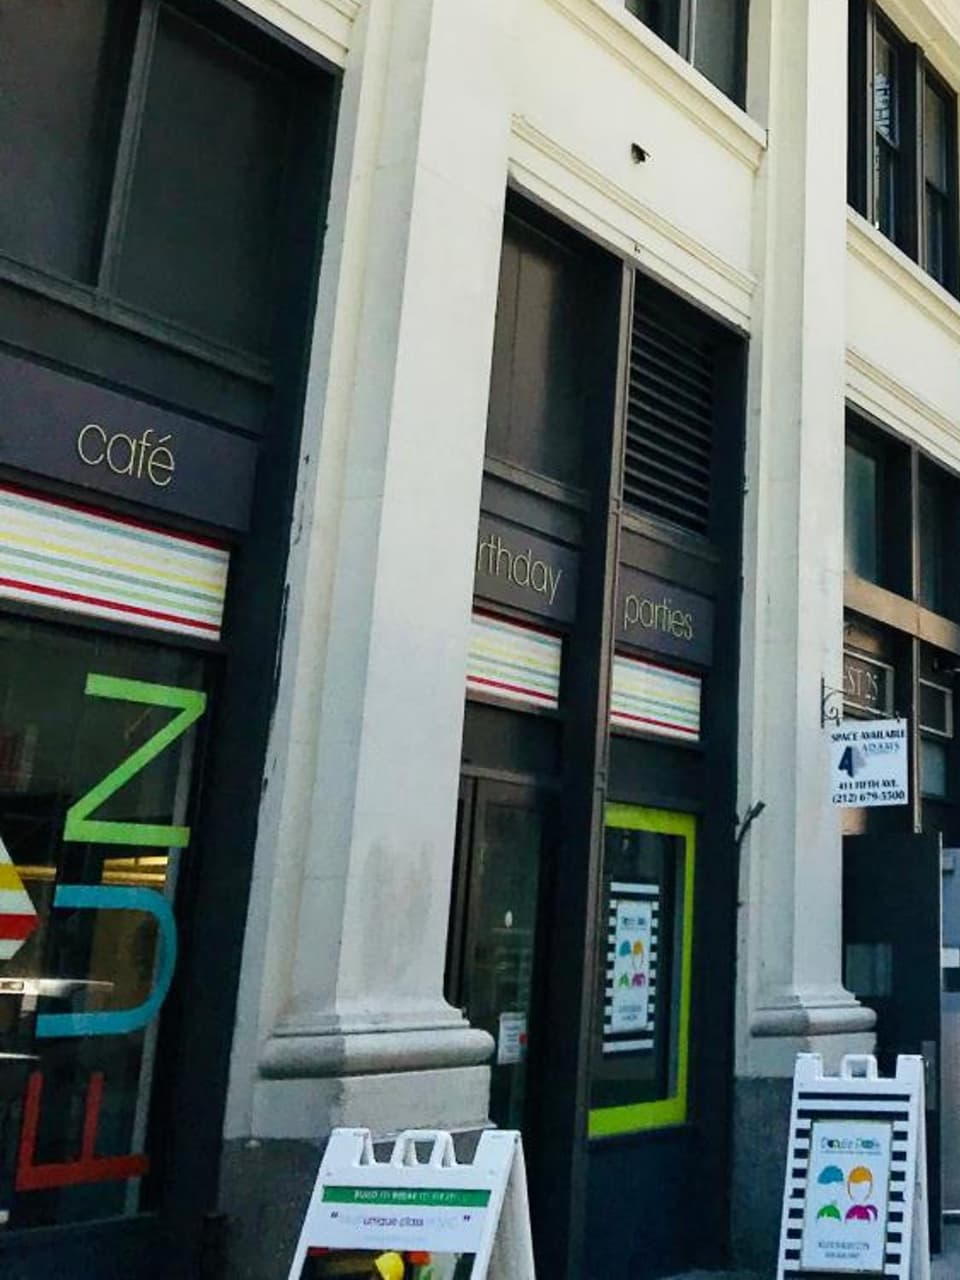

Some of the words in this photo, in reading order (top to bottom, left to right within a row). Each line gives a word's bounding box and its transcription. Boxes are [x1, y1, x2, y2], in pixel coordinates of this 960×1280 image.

[78, 423, 175, 486] café
[624, 592, 694, 642] parties
[831, 730, 859, 741] SPACE
[861, 728, 905, 740] AVAILABLE
[855, 780, 880, 790] FIFTH
[832, 792, 858, 804] (212)
